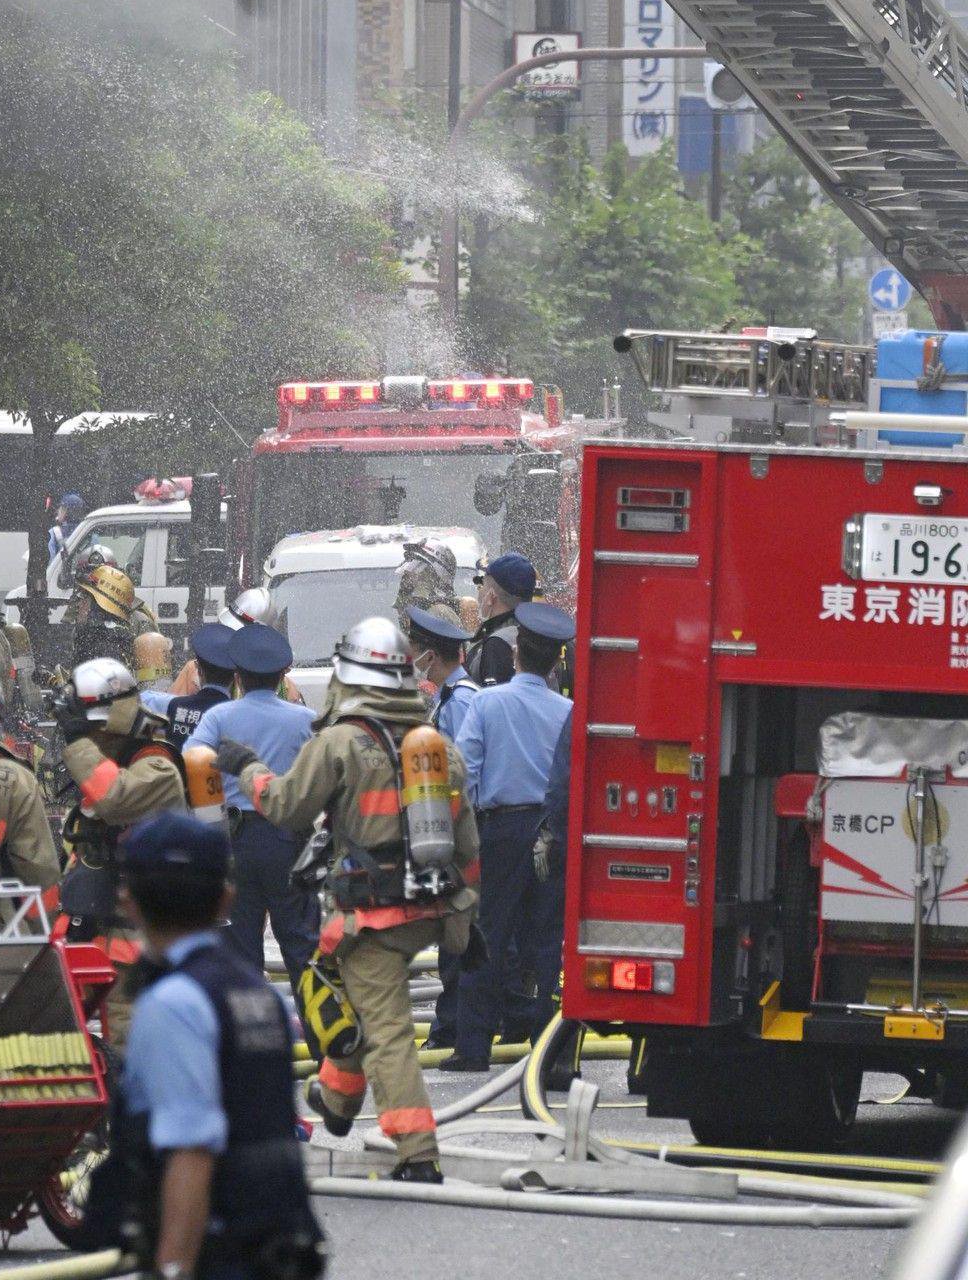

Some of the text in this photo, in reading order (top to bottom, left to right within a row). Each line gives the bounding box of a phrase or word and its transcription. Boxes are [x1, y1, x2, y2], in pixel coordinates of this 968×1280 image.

[893, 539, 968, 578] 19-6
[174, 707, 204, 725] 警視
[411, 752, 442, 774] 300
